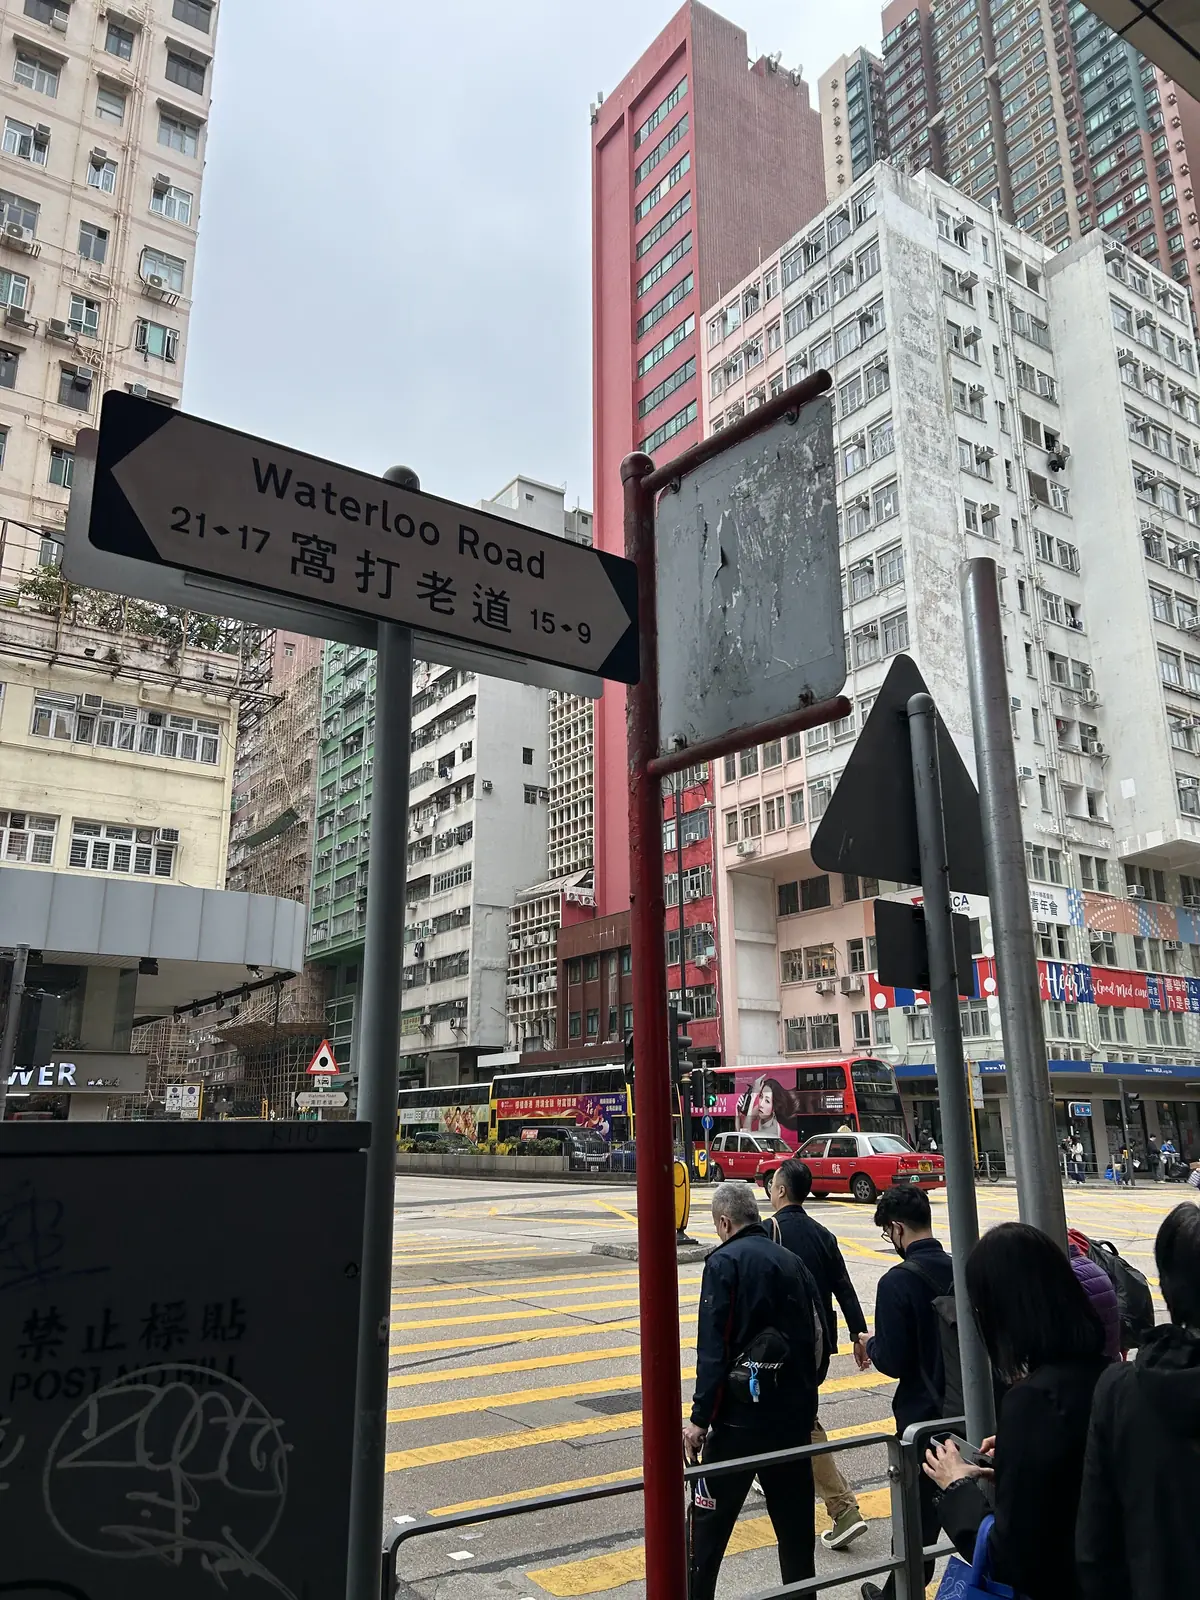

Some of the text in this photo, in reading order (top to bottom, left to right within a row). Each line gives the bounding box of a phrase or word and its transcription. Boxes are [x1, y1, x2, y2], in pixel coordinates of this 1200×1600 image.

[252, 457, 545, 580] Waterloo Road
[170, 506, 592, 644] 21 17 窩打老道 15 9
[950, 895, 969, 907] CA
[1030, 897, 1058, 916] 青年會
[1045, 963, 1088, 1000] Heart
[1097, 979, 1115, 996] Good
[1115, 983, 1149, 998] Medcine
[1164, 977, 1198, 994] 喜樂的心
[1168, 995, 1200, 1011] 乃是良藥
[985, 1063, 1006, 1071] www.Y
[17, 1298, 247, 1362] 禁止標貼
[10, 1366, 102, 1402] POST
[118, 1362, 164, 1388] NO
